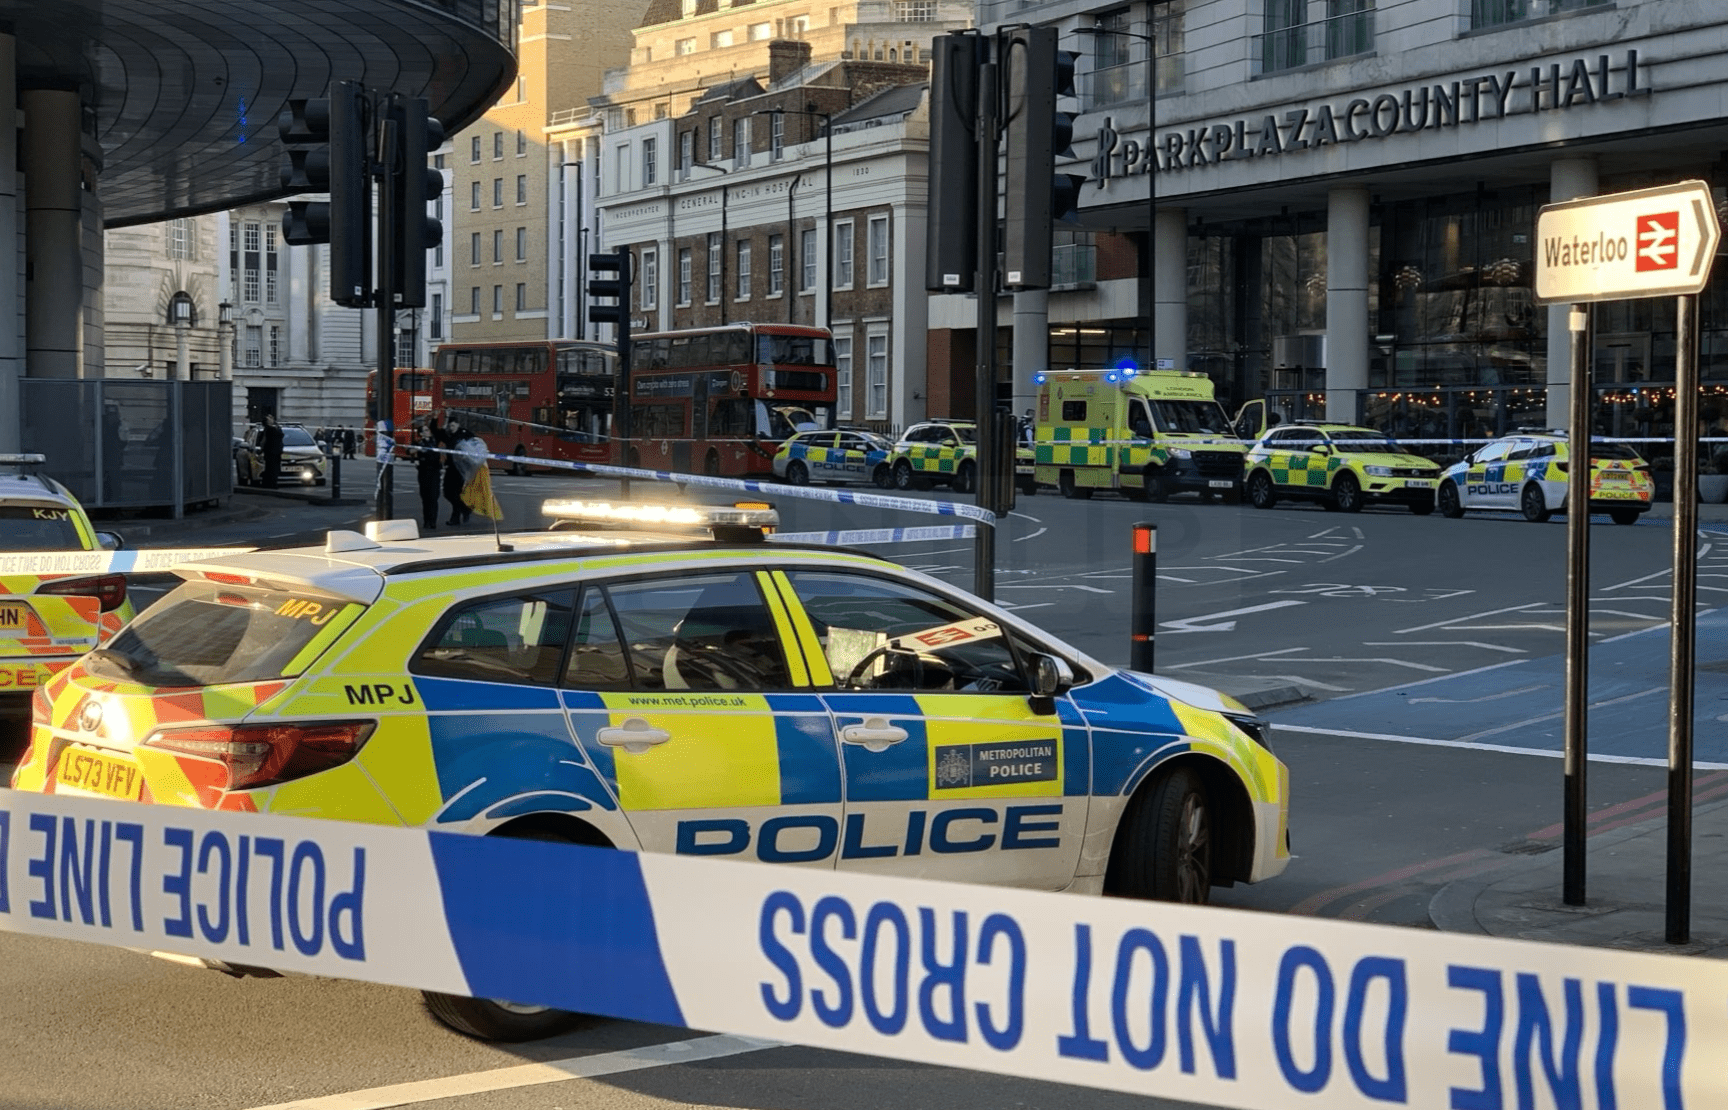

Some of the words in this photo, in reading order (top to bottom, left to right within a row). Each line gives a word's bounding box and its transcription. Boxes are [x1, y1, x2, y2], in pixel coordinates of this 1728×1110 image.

[1344, 71, 1515, 142] COUNTY
[1530, 49, 1653, 112] HALL
[681, 196, 718, 209] GENERAL
[723, 185, 760, 203] YING-IN
[1545, 230, 1628, 268] Waterloo
[813, 462, 866, 472] POLICE
[1468, 483, 1519, 495] POLICE
[33, 509, 67, 522] KJY
[275, 599, 336, 625] MPJ
[345, 684, 415, 706] MPJ
[629, 695, 746, 708] www.met.police.uk
[979, 746, 1051, 762] METROPOLITAN
[989, 762, 1042, 778] POLICE
[62, 752, 101, 783] LS73
[106, 763, 137, 795] VFV
[675, 804, 1063, 864] POLICE
[28, 813, 144, 932] LINE
[163, 827, 367, 962] POLICE
[759, 890, 1027, 1051] CROSS
[1057, 922, 1237, 1081] NOT
[1272, 933, 1408, 1103] DO
[1447, 964, 1687, 1110] LINE
